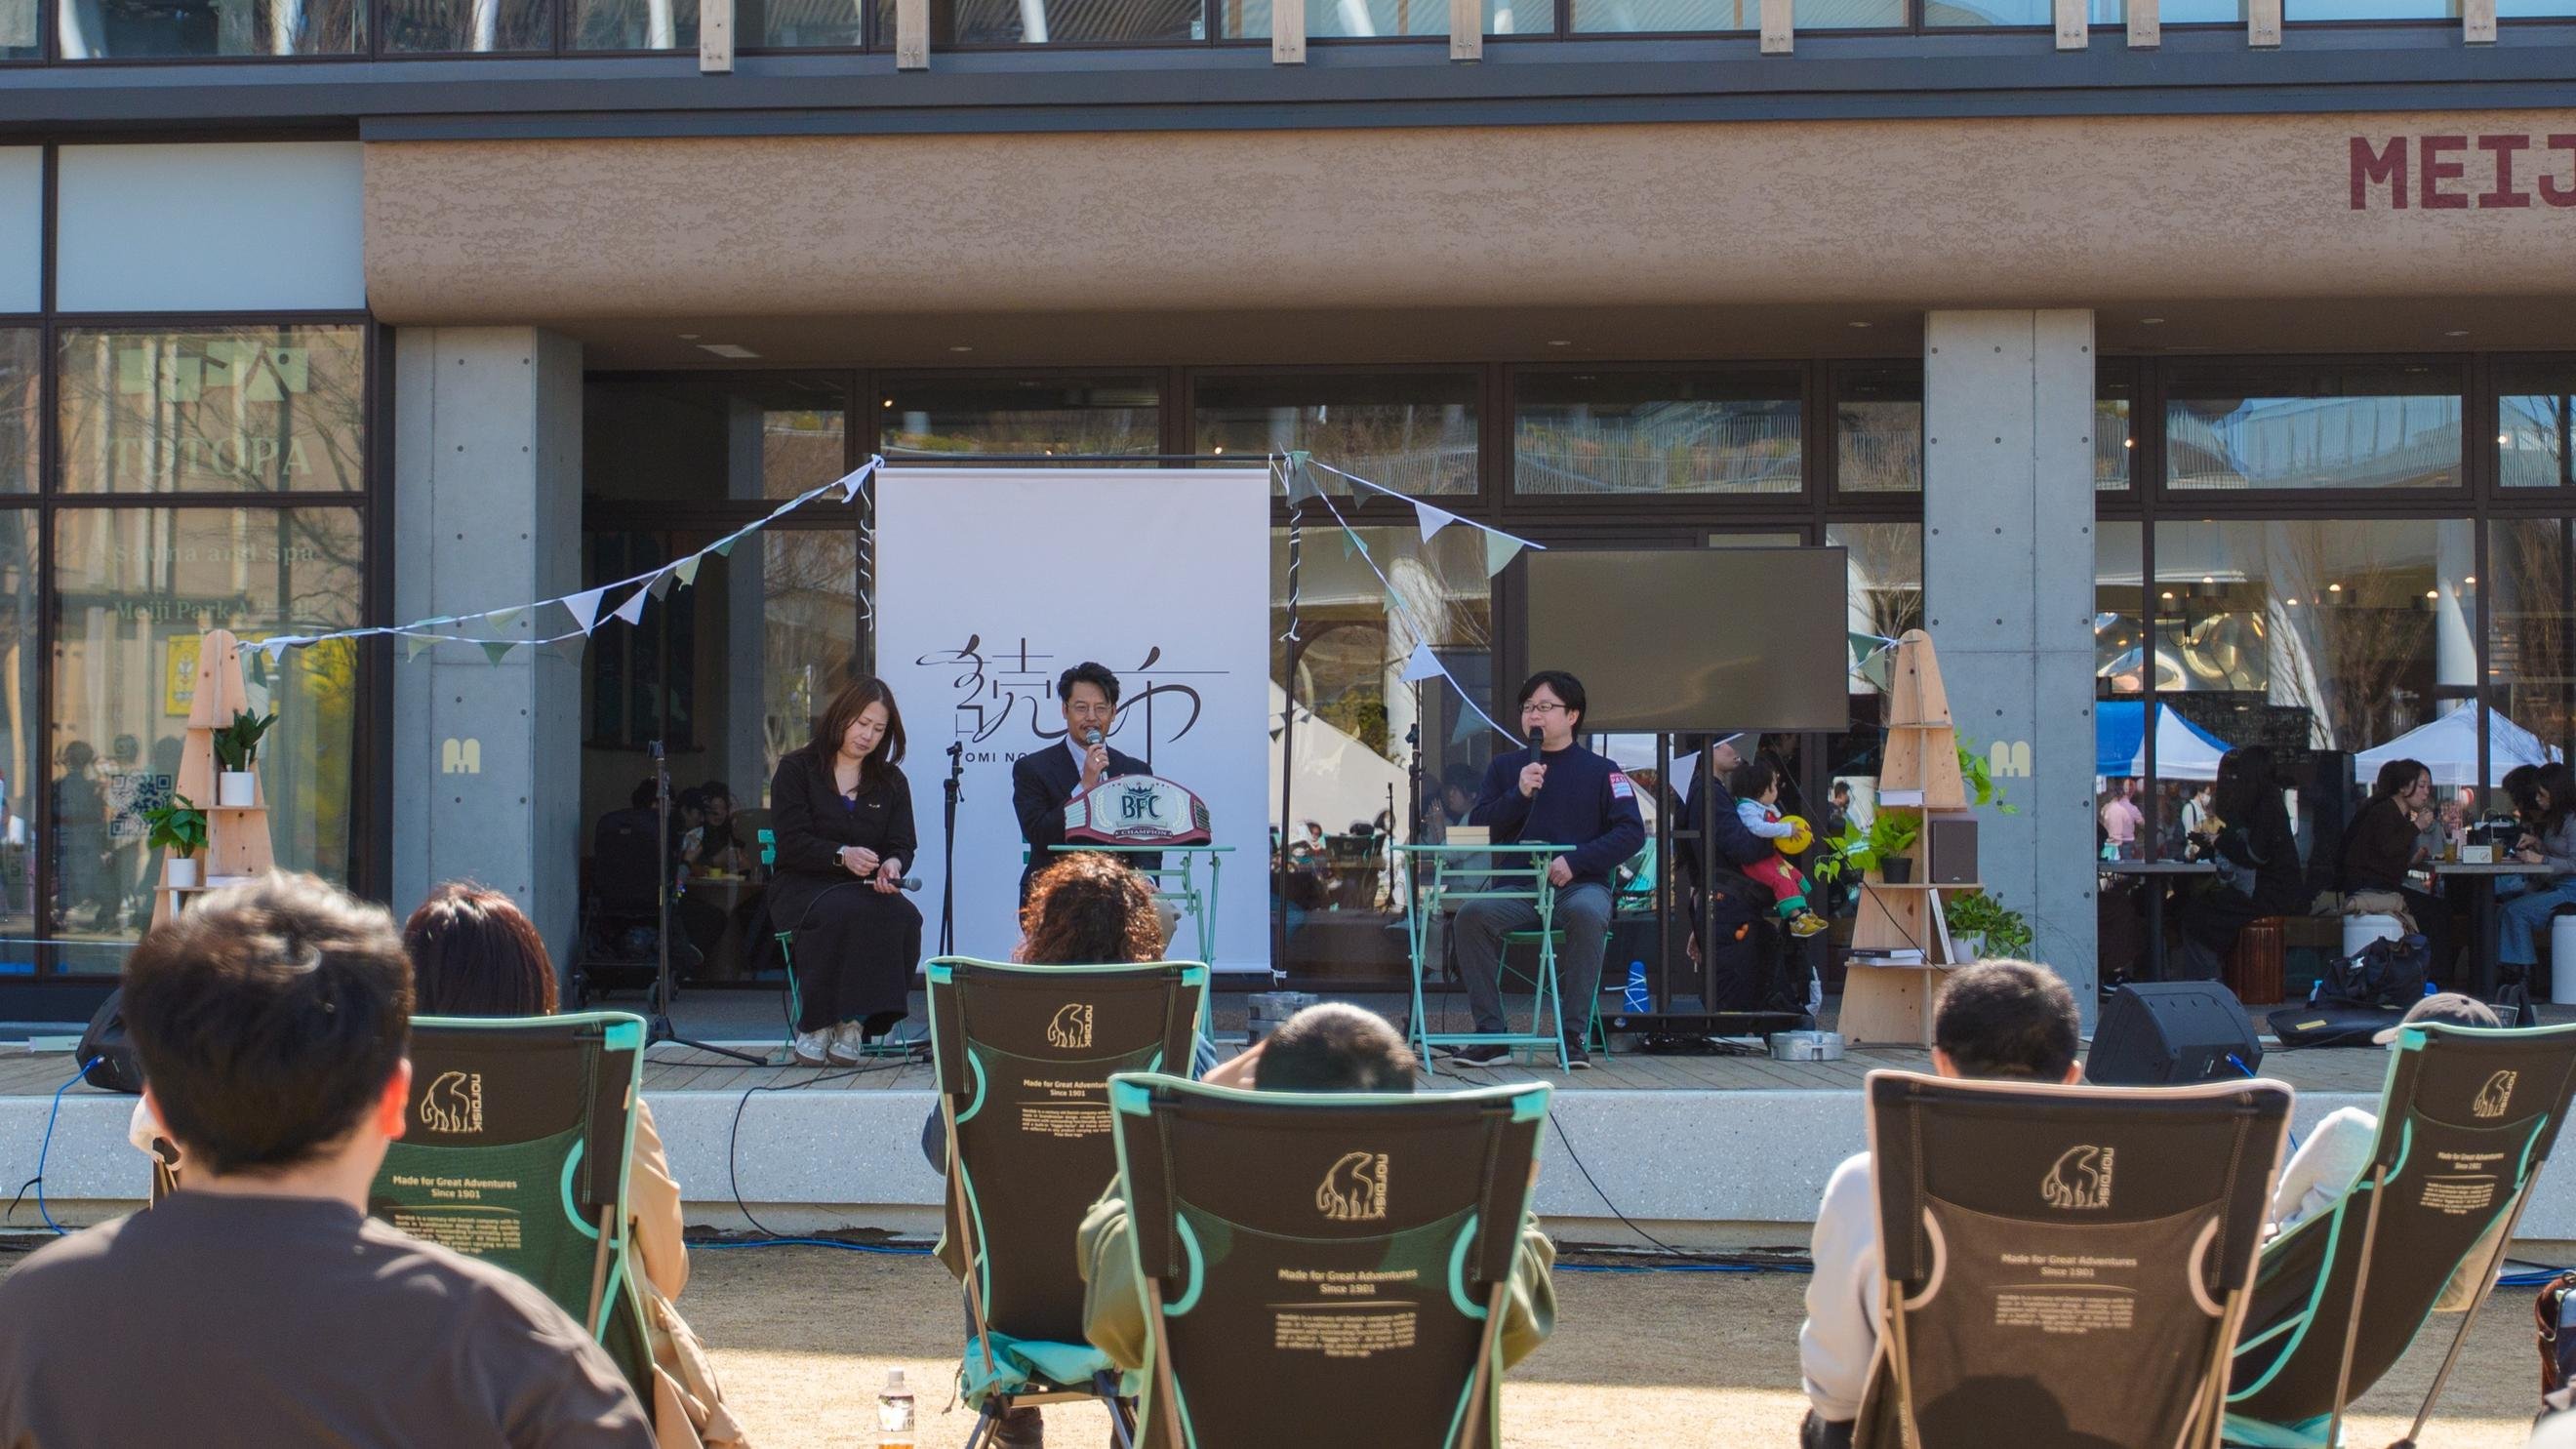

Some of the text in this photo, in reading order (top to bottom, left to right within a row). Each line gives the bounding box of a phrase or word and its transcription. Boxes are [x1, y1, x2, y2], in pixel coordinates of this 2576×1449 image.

[960, 752, 995, 762] OMI
[1121, 794, 1162, 819] BFC
[392, 1175, 517, 1189] Made for Great Adventures
[431, 1188, 481, 1199] Since 1901
[2001, 1253, 2137, 1268] Made for Great Adventures
[1278, 1268, 1419, 1281] Made for Great Adventures
[2039, 1267, 2095, 1278] Since 1901
[1319, 1283, 1377, 1295] Since 1901
